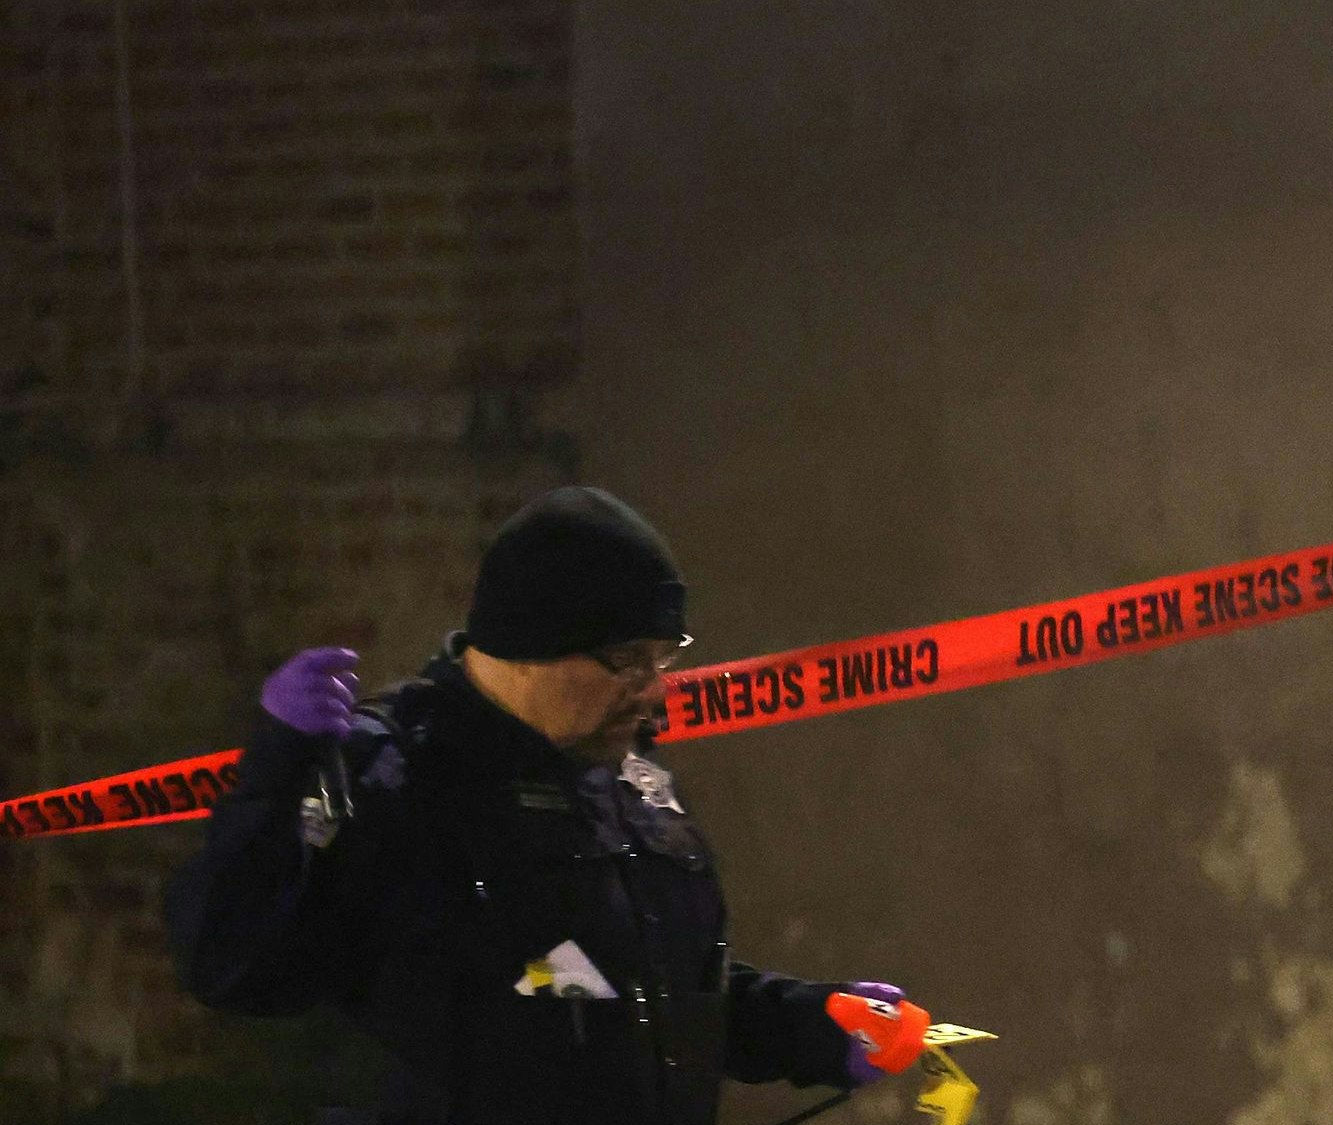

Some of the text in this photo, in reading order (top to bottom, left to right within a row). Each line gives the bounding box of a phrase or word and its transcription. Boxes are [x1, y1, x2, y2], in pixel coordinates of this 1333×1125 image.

[1096, 589, 1184, 649] KEEP
[1195, 563, 1303, 629] SCENE
[1016, 610, 1084, 667] OUT
[681, 664, 805, 727] SCENE
[819, 639, 940, 702] CRIME
